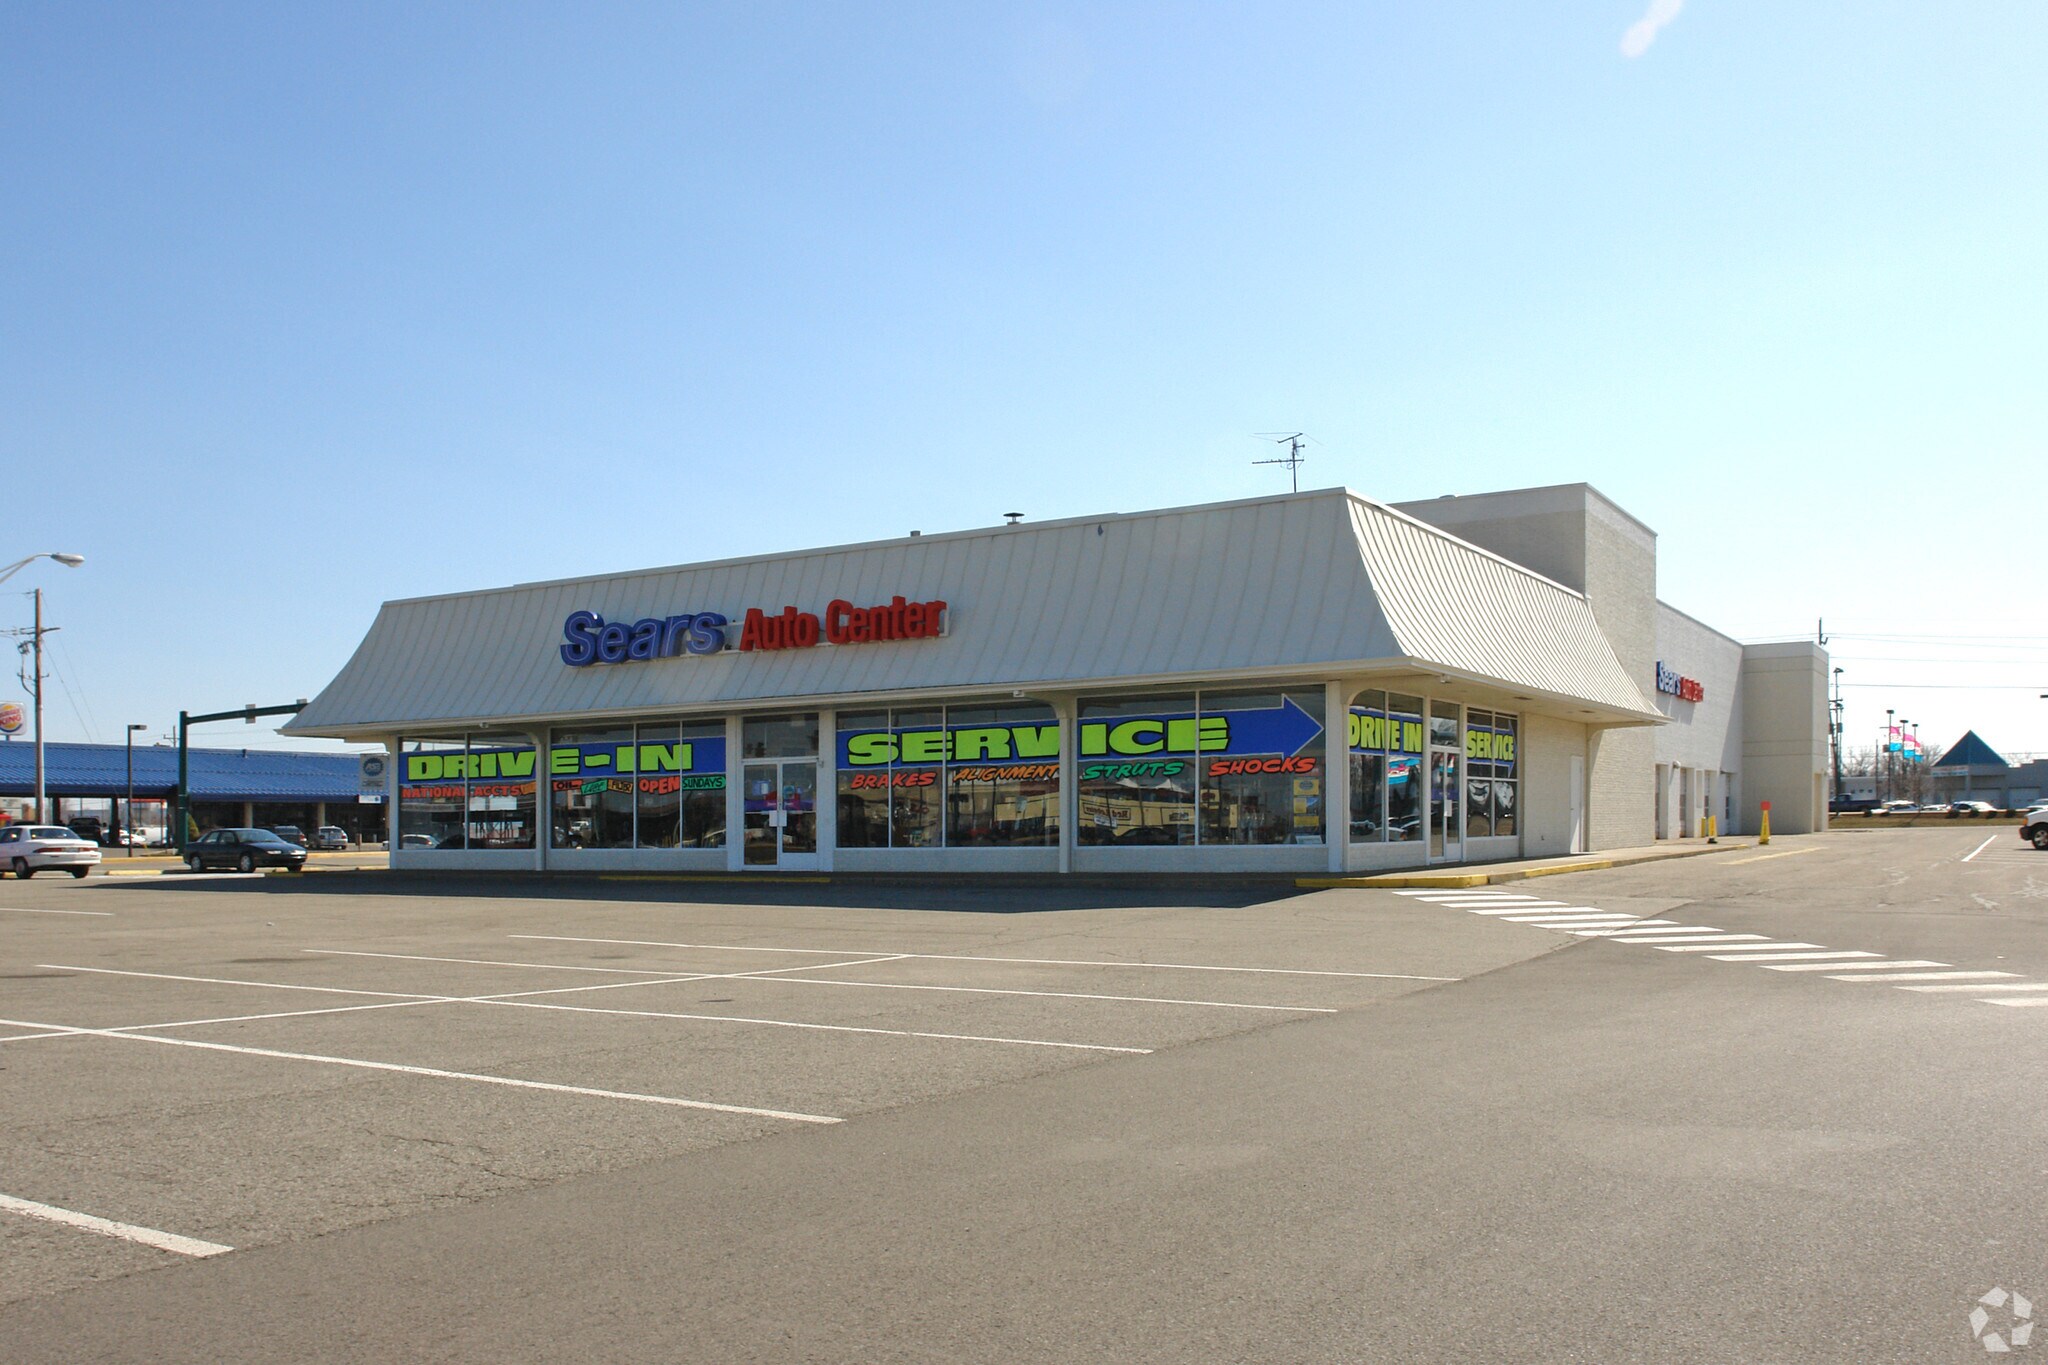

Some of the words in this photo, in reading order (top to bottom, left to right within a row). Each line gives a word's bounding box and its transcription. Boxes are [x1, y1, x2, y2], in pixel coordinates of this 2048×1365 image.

[561, 610, 727, 667] Sears
[739, 605, 819, 651] Auto
[825, 596, 947, 644] Center
[847, 716, 1230, 766] SERVICE
[1349, 713, 1400, 750] DRIVE
[1403, 721, 1423, 753] IN
[1466, 730, 1514, 761] SERVICE
[407, 743, 693, 781] DRIVE-IN
[1083, 761, 1184, 780] STRUTS
[1208, 756, 1316, 777] SHOCKS
[682, 776, 723, 788] SUNDAYS
[851, 772, 937, 789] BRAKES
[953, 764, 1059, 782] ALIGNMENT
[638, 776, 681, 795] OPEN
